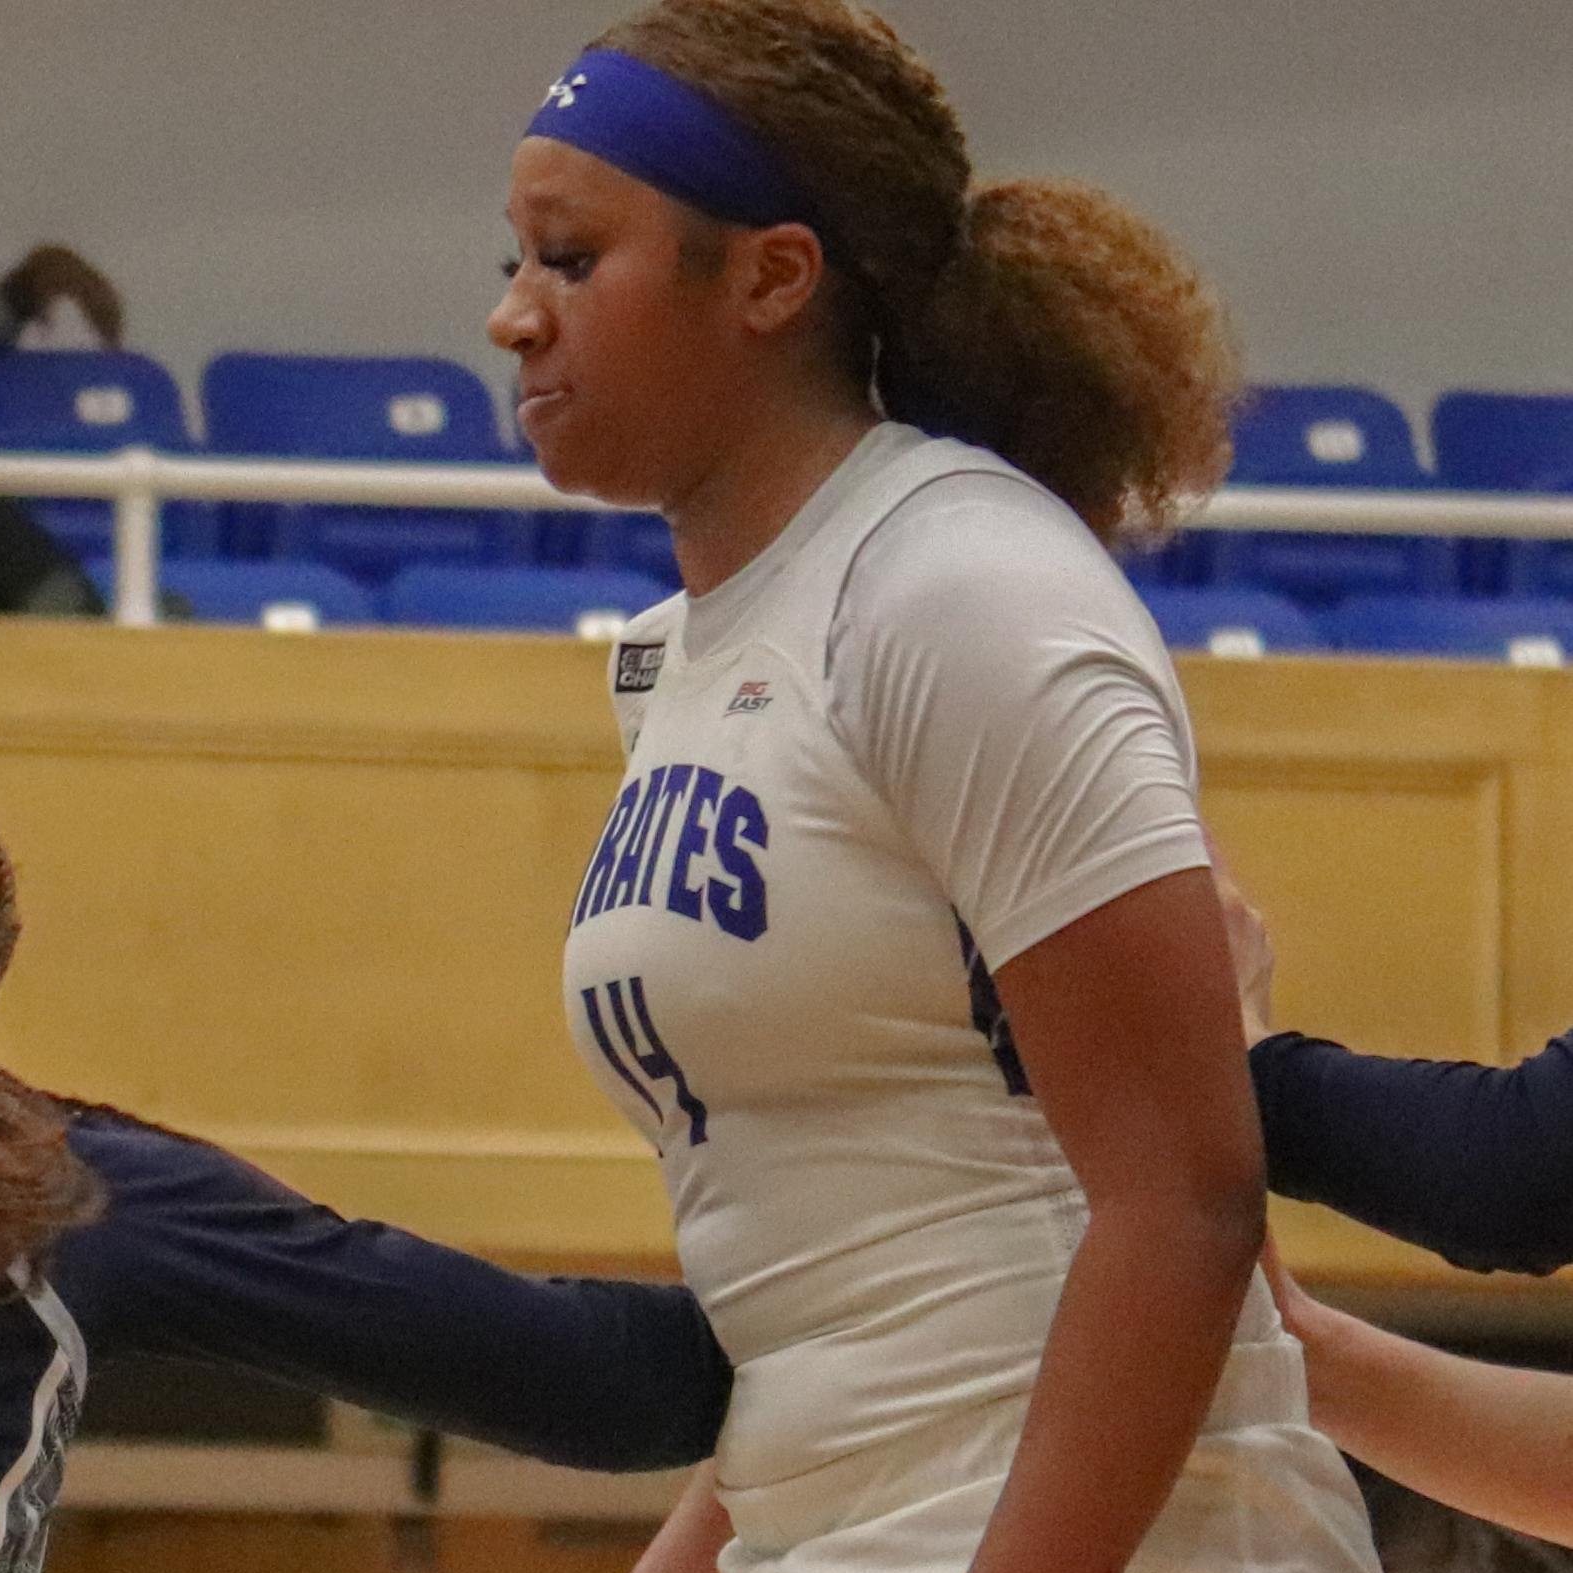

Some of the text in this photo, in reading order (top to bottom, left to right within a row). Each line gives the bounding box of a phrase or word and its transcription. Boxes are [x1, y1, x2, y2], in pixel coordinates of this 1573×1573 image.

[726, 697, 774, 711] EAST
[737, 681, 771, 697] BIG
[569, 764, 768, 942] RATES
[581, 976, 709, 1159] 14
